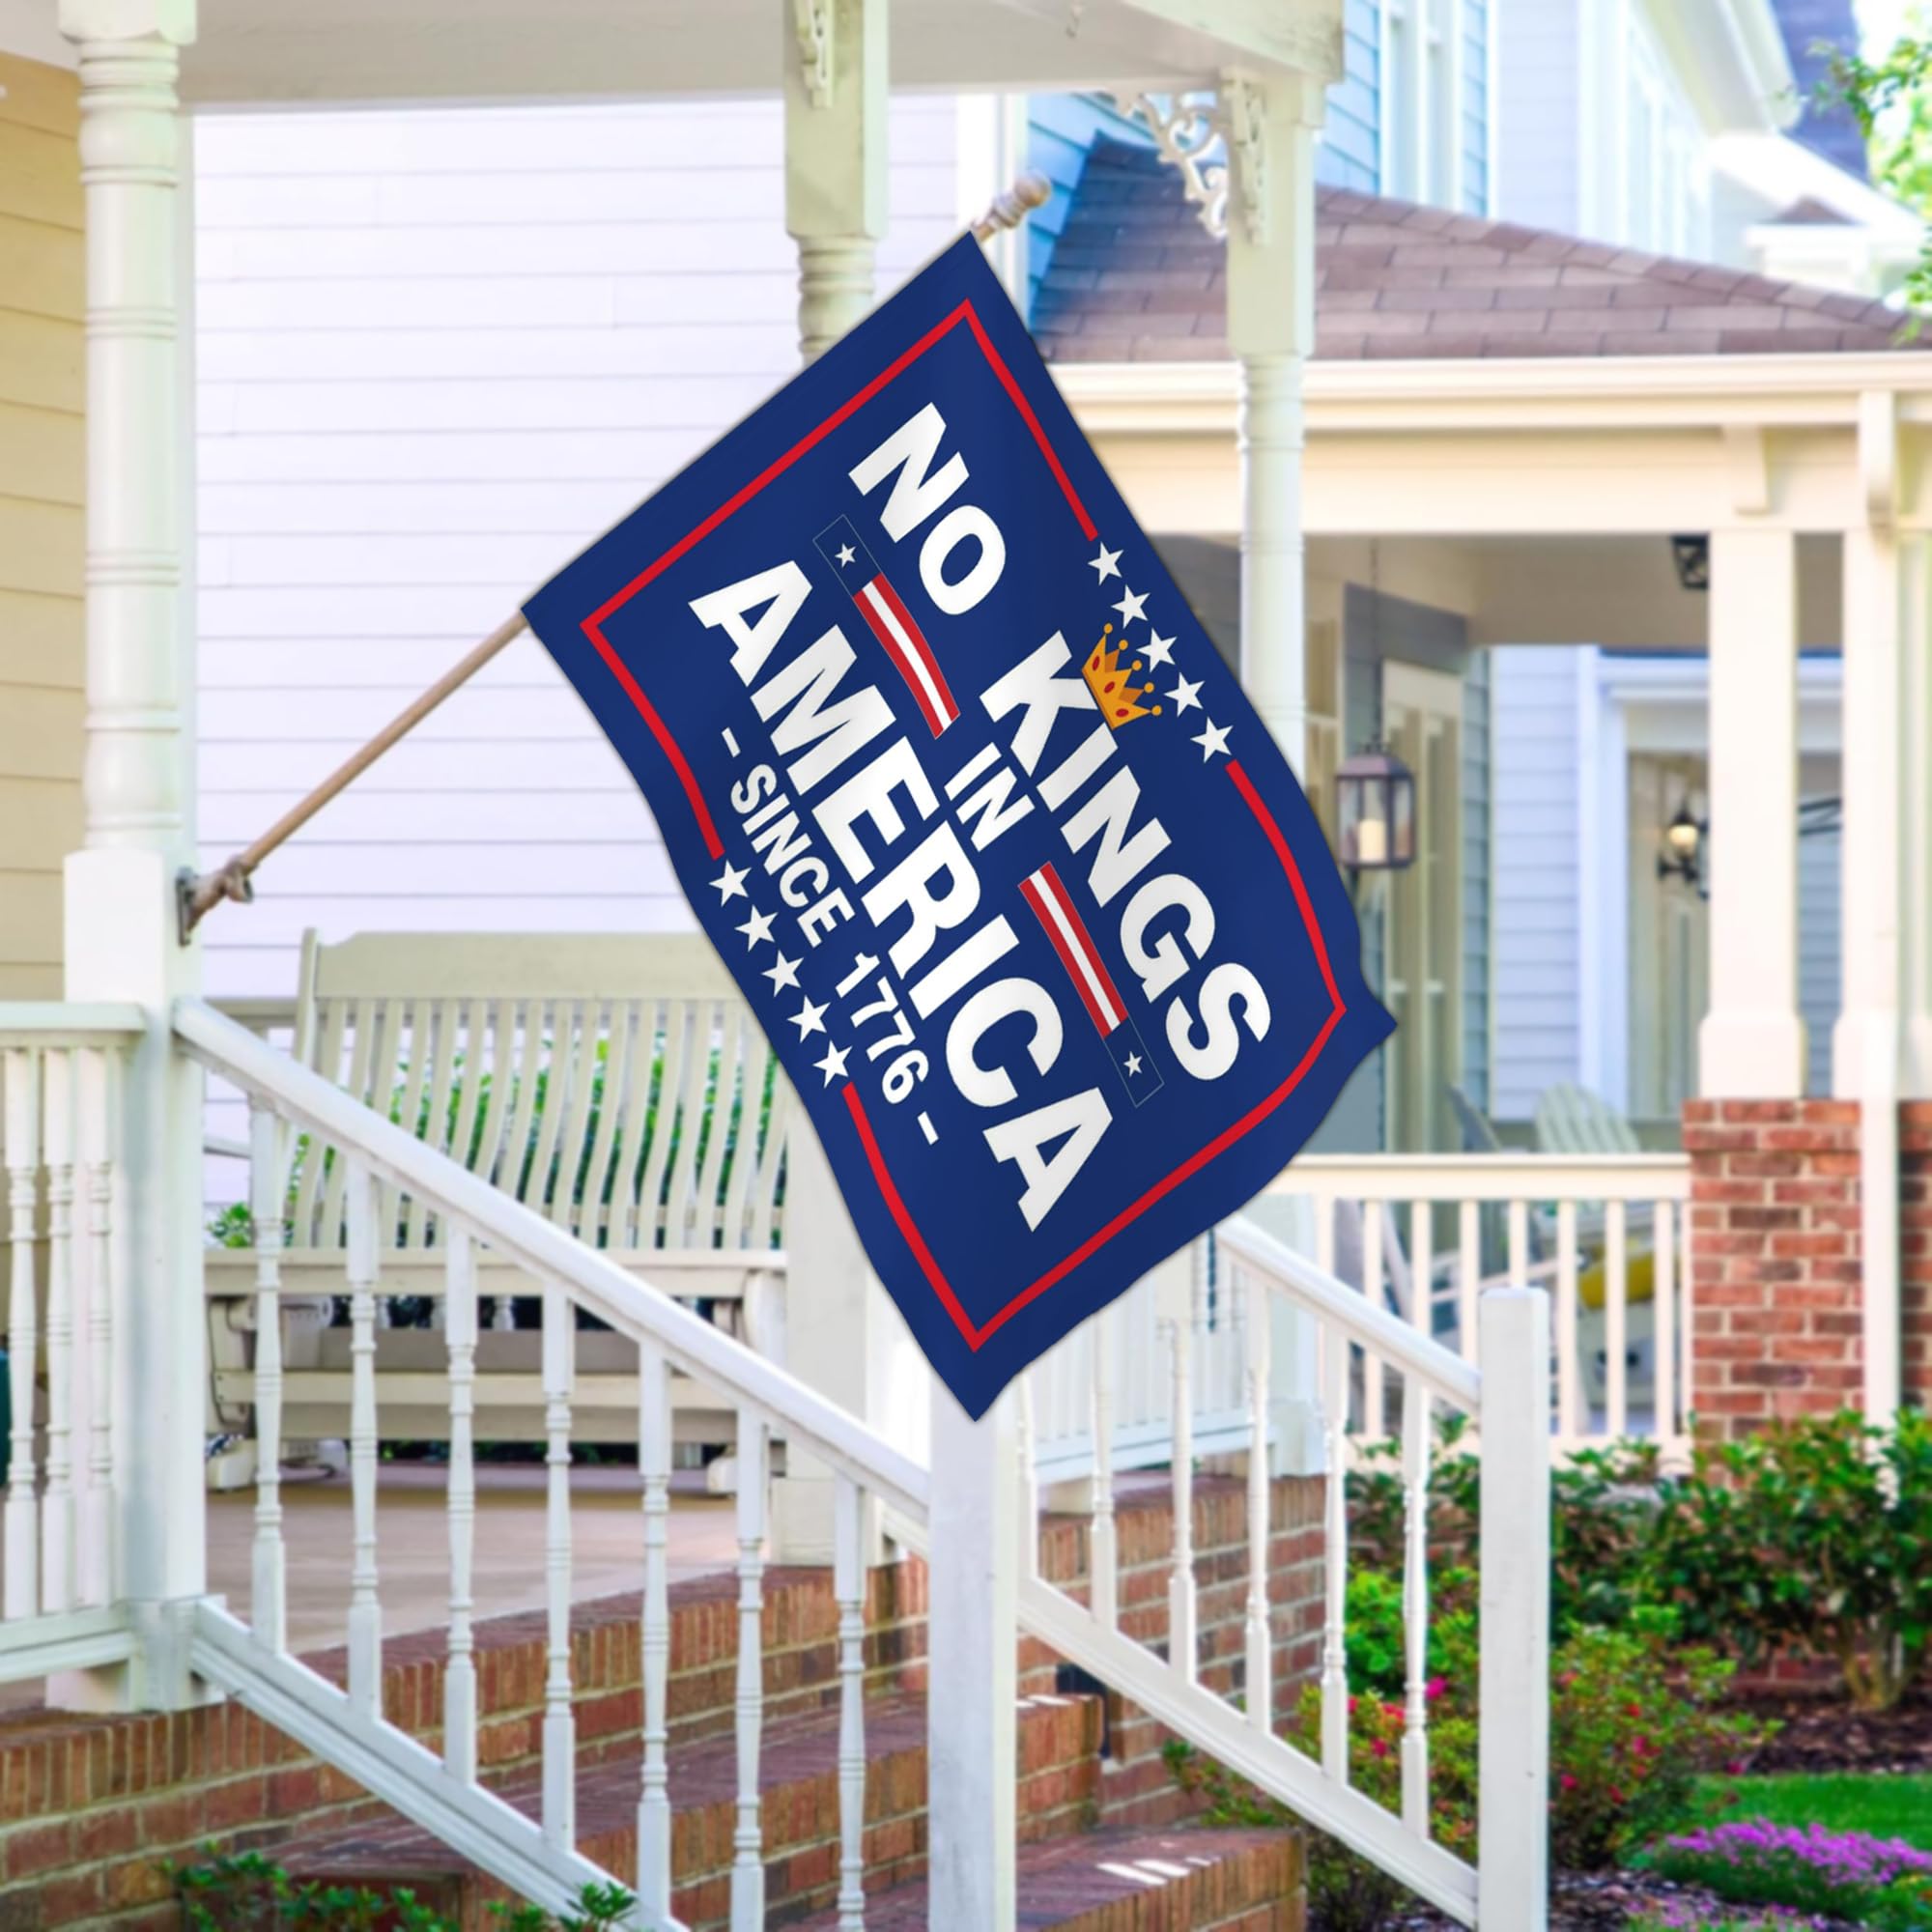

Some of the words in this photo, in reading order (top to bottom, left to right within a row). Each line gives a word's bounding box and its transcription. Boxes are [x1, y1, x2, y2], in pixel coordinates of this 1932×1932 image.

[688, 560, 1113, 1232] AMERICA
[730, 764, 856, 948] SINCE
[835, 952, 929, 1104] 1776
[848, 402, 1007, 615] NO
[979, 630, 1271, 1081] KINGS
[944, 742, 1036, 852] IN
